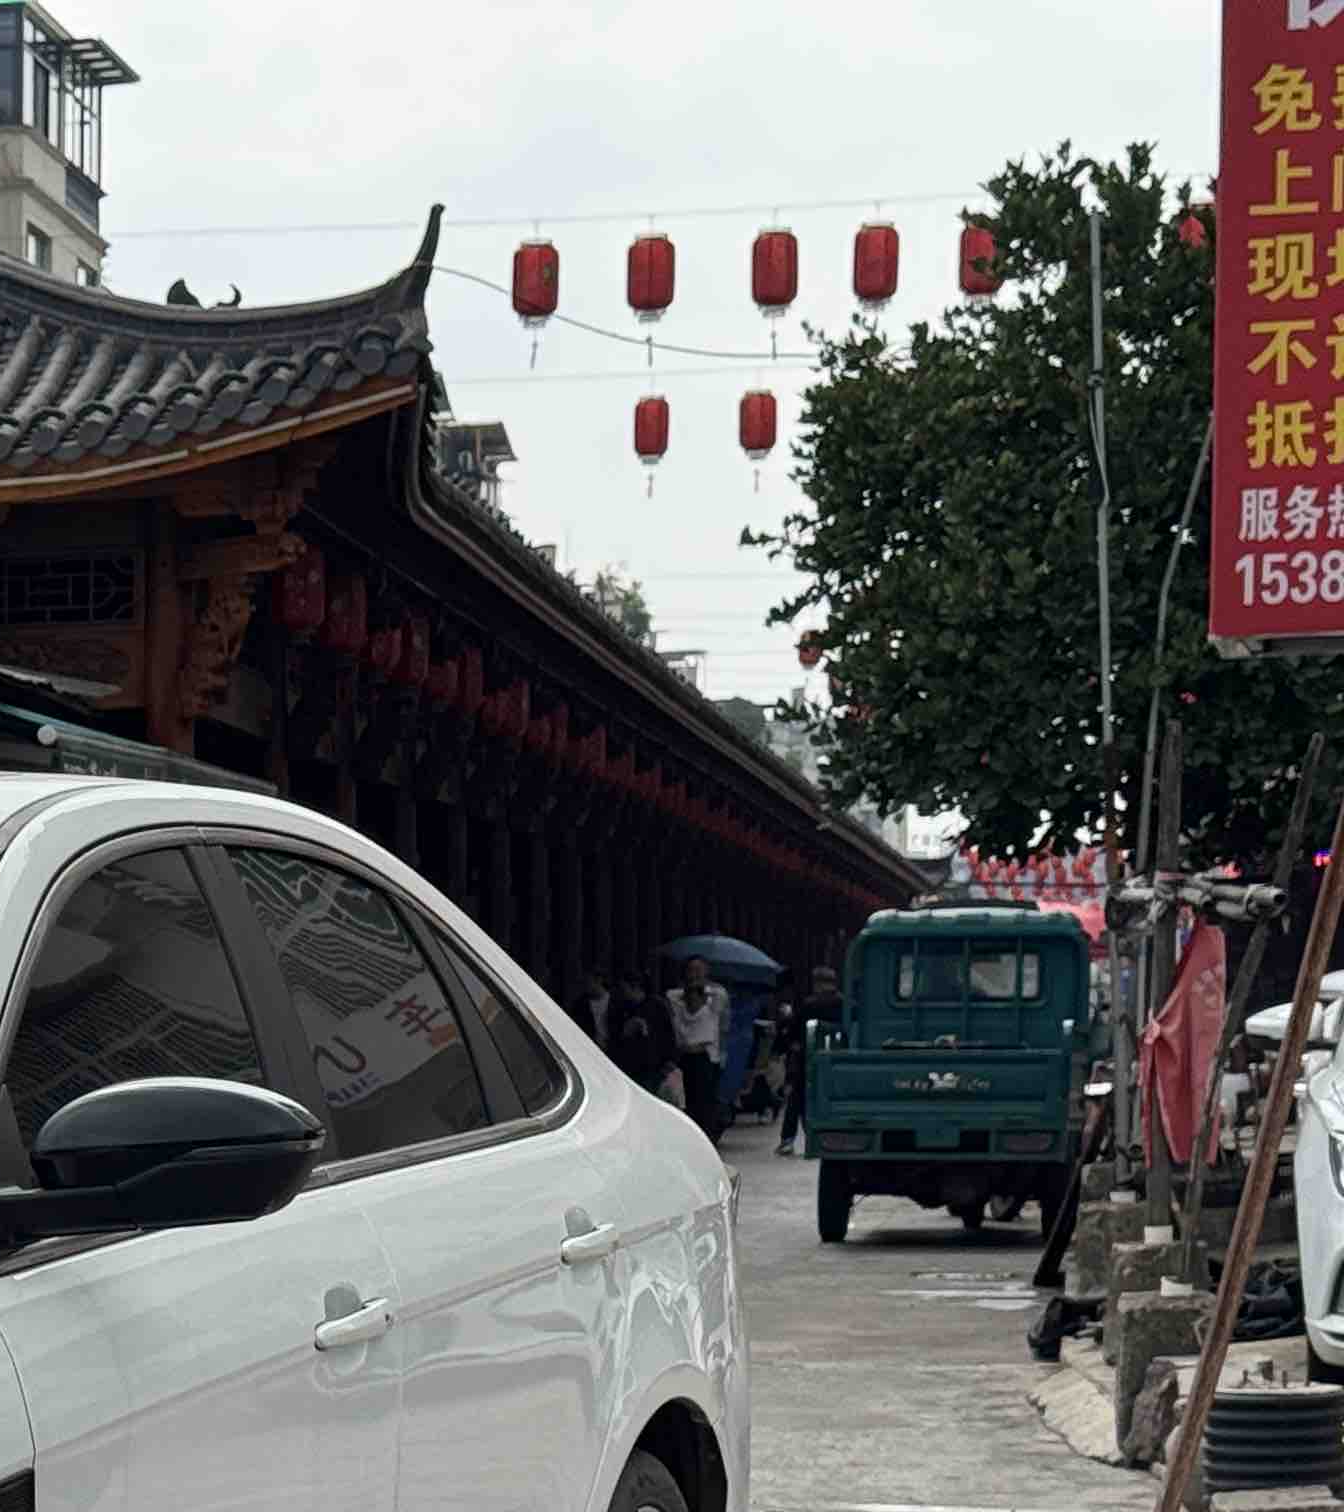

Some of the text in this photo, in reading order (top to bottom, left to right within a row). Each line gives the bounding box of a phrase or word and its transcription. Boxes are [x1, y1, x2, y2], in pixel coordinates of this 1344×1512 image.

[1250, 63, 1344, 135] 免
[1248, 149, 1344, 216] 上
[1234, 550, 1344, 607] 1538
